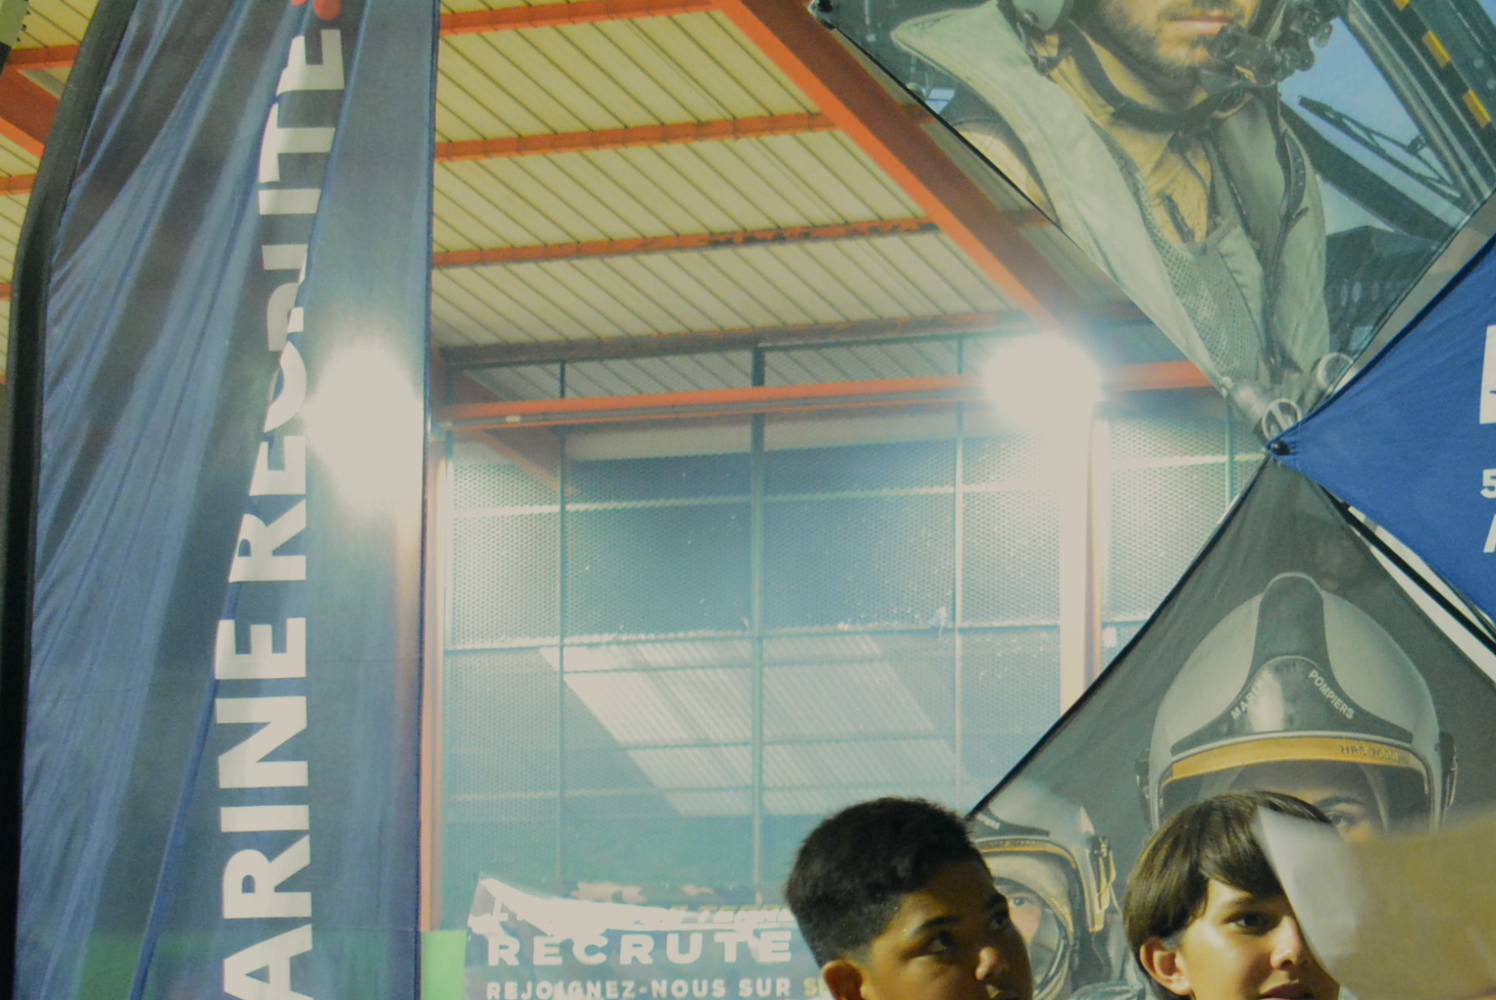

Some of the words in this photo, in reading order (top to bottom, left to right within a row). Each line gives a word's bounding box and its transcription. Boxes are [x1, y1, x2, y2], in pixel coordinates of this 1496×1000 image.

[1307, 668, 1355, 720] POMPIERS
[486, 930, 793, 967] RECRUTE
[738, 977, 792, 998] SUR
